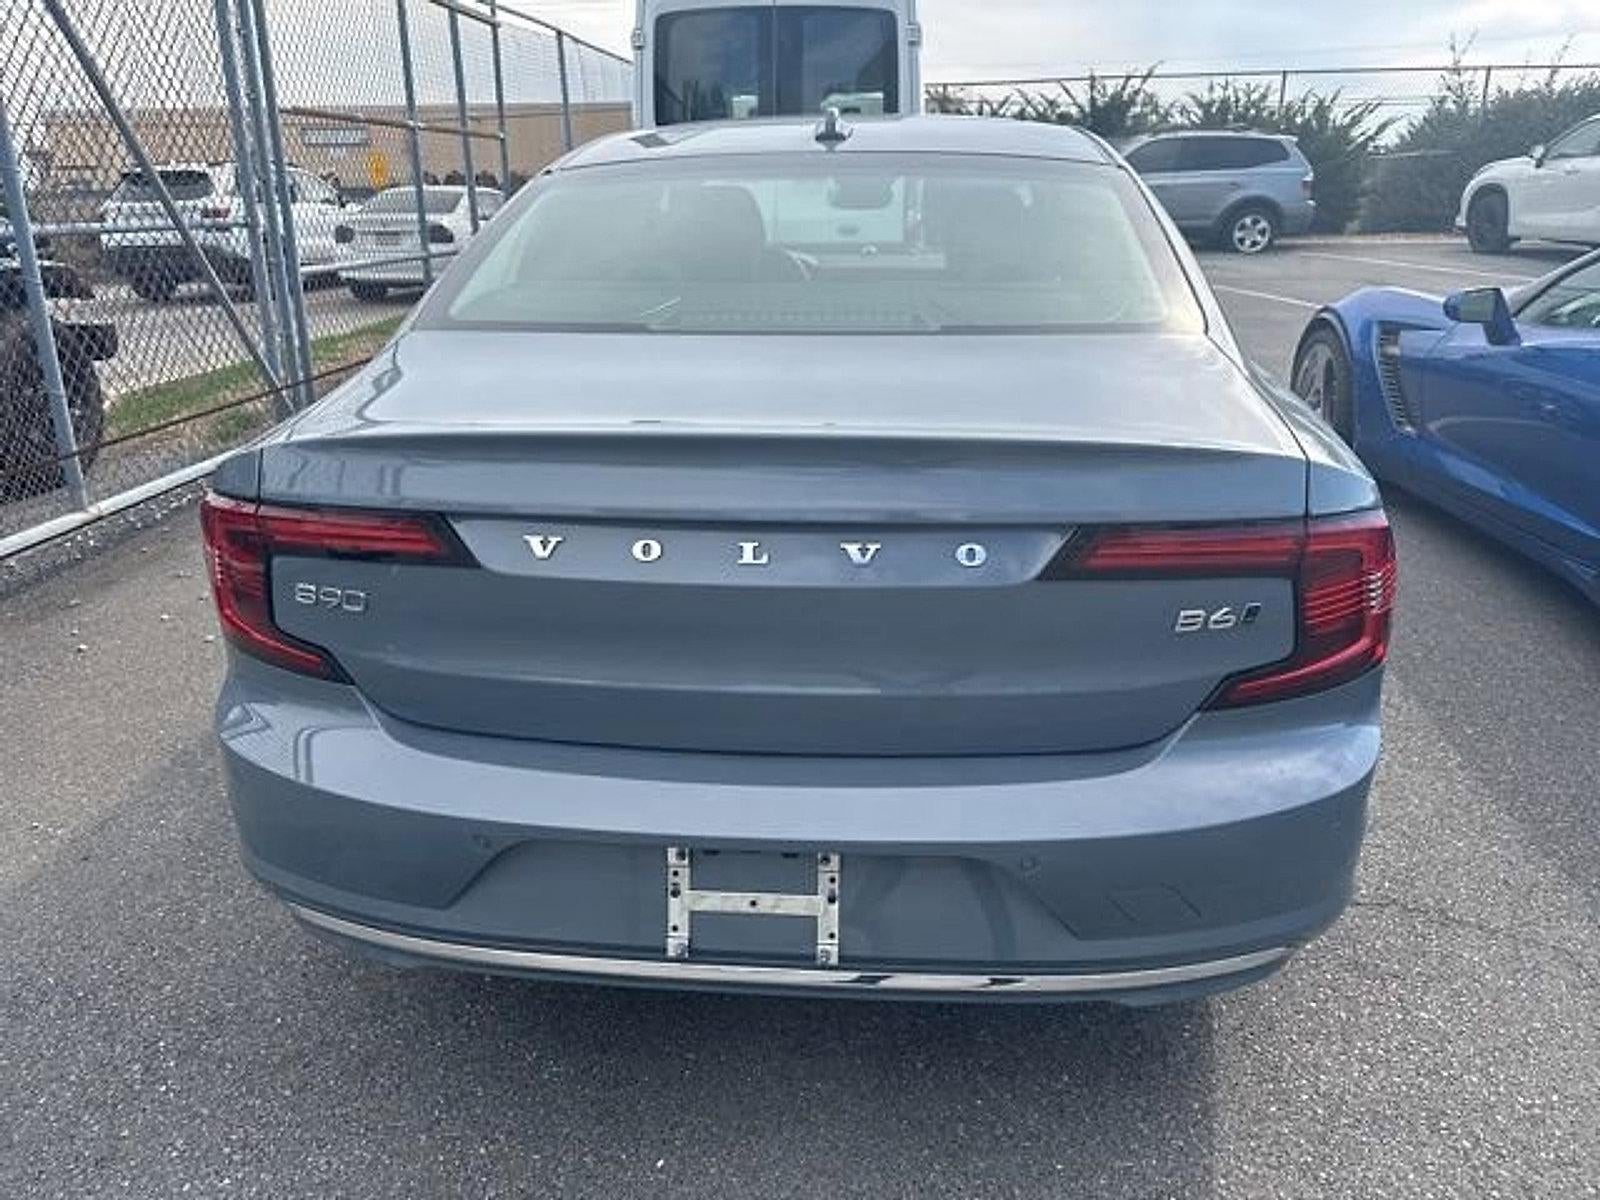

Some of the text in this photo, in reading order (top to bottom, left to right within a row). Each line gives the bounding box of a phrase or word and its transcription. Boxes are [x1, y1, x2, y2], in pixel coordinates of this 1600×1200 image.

[523, 534, 988, 567] VOLVO
[295, 582, 366, 611] S90
[1175, 607, 1236, 632] B6
